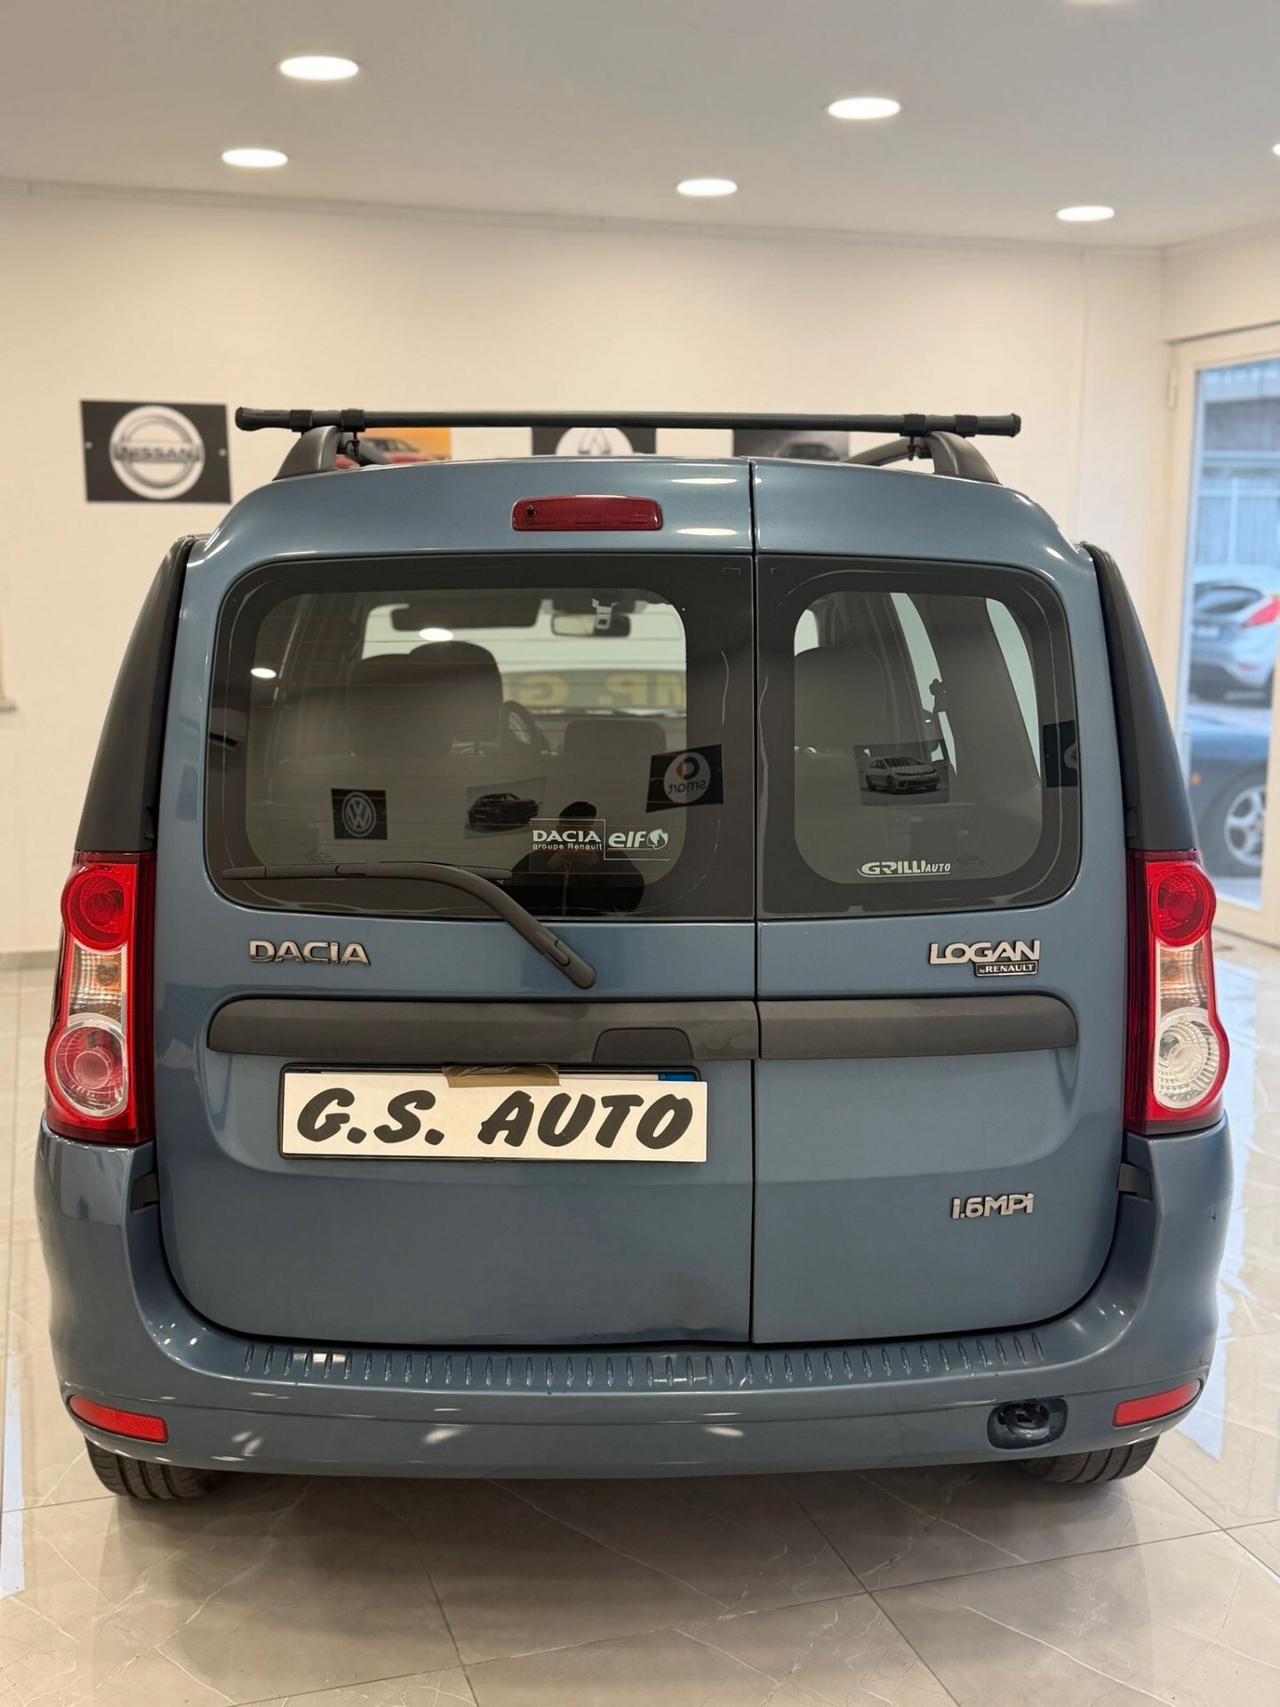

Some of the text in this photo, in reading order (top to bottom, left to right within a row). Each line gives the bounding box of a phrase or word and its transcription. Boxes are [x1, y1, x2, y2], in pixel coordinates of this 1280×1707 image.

[118, 446, 195, 460] NISSAN
[532, 830, 602, 842] DACIA
[608, 830, 647, 848] elf
[532, 842, 603, 850] groupe Renault
[248, 940, 371, 966] DACIA
[929, 939, 1041, 965] LOGAN
[985, 964, 1034, 973] RENAULT
[297, 1087, 694, 1150] G.S. AUTO
